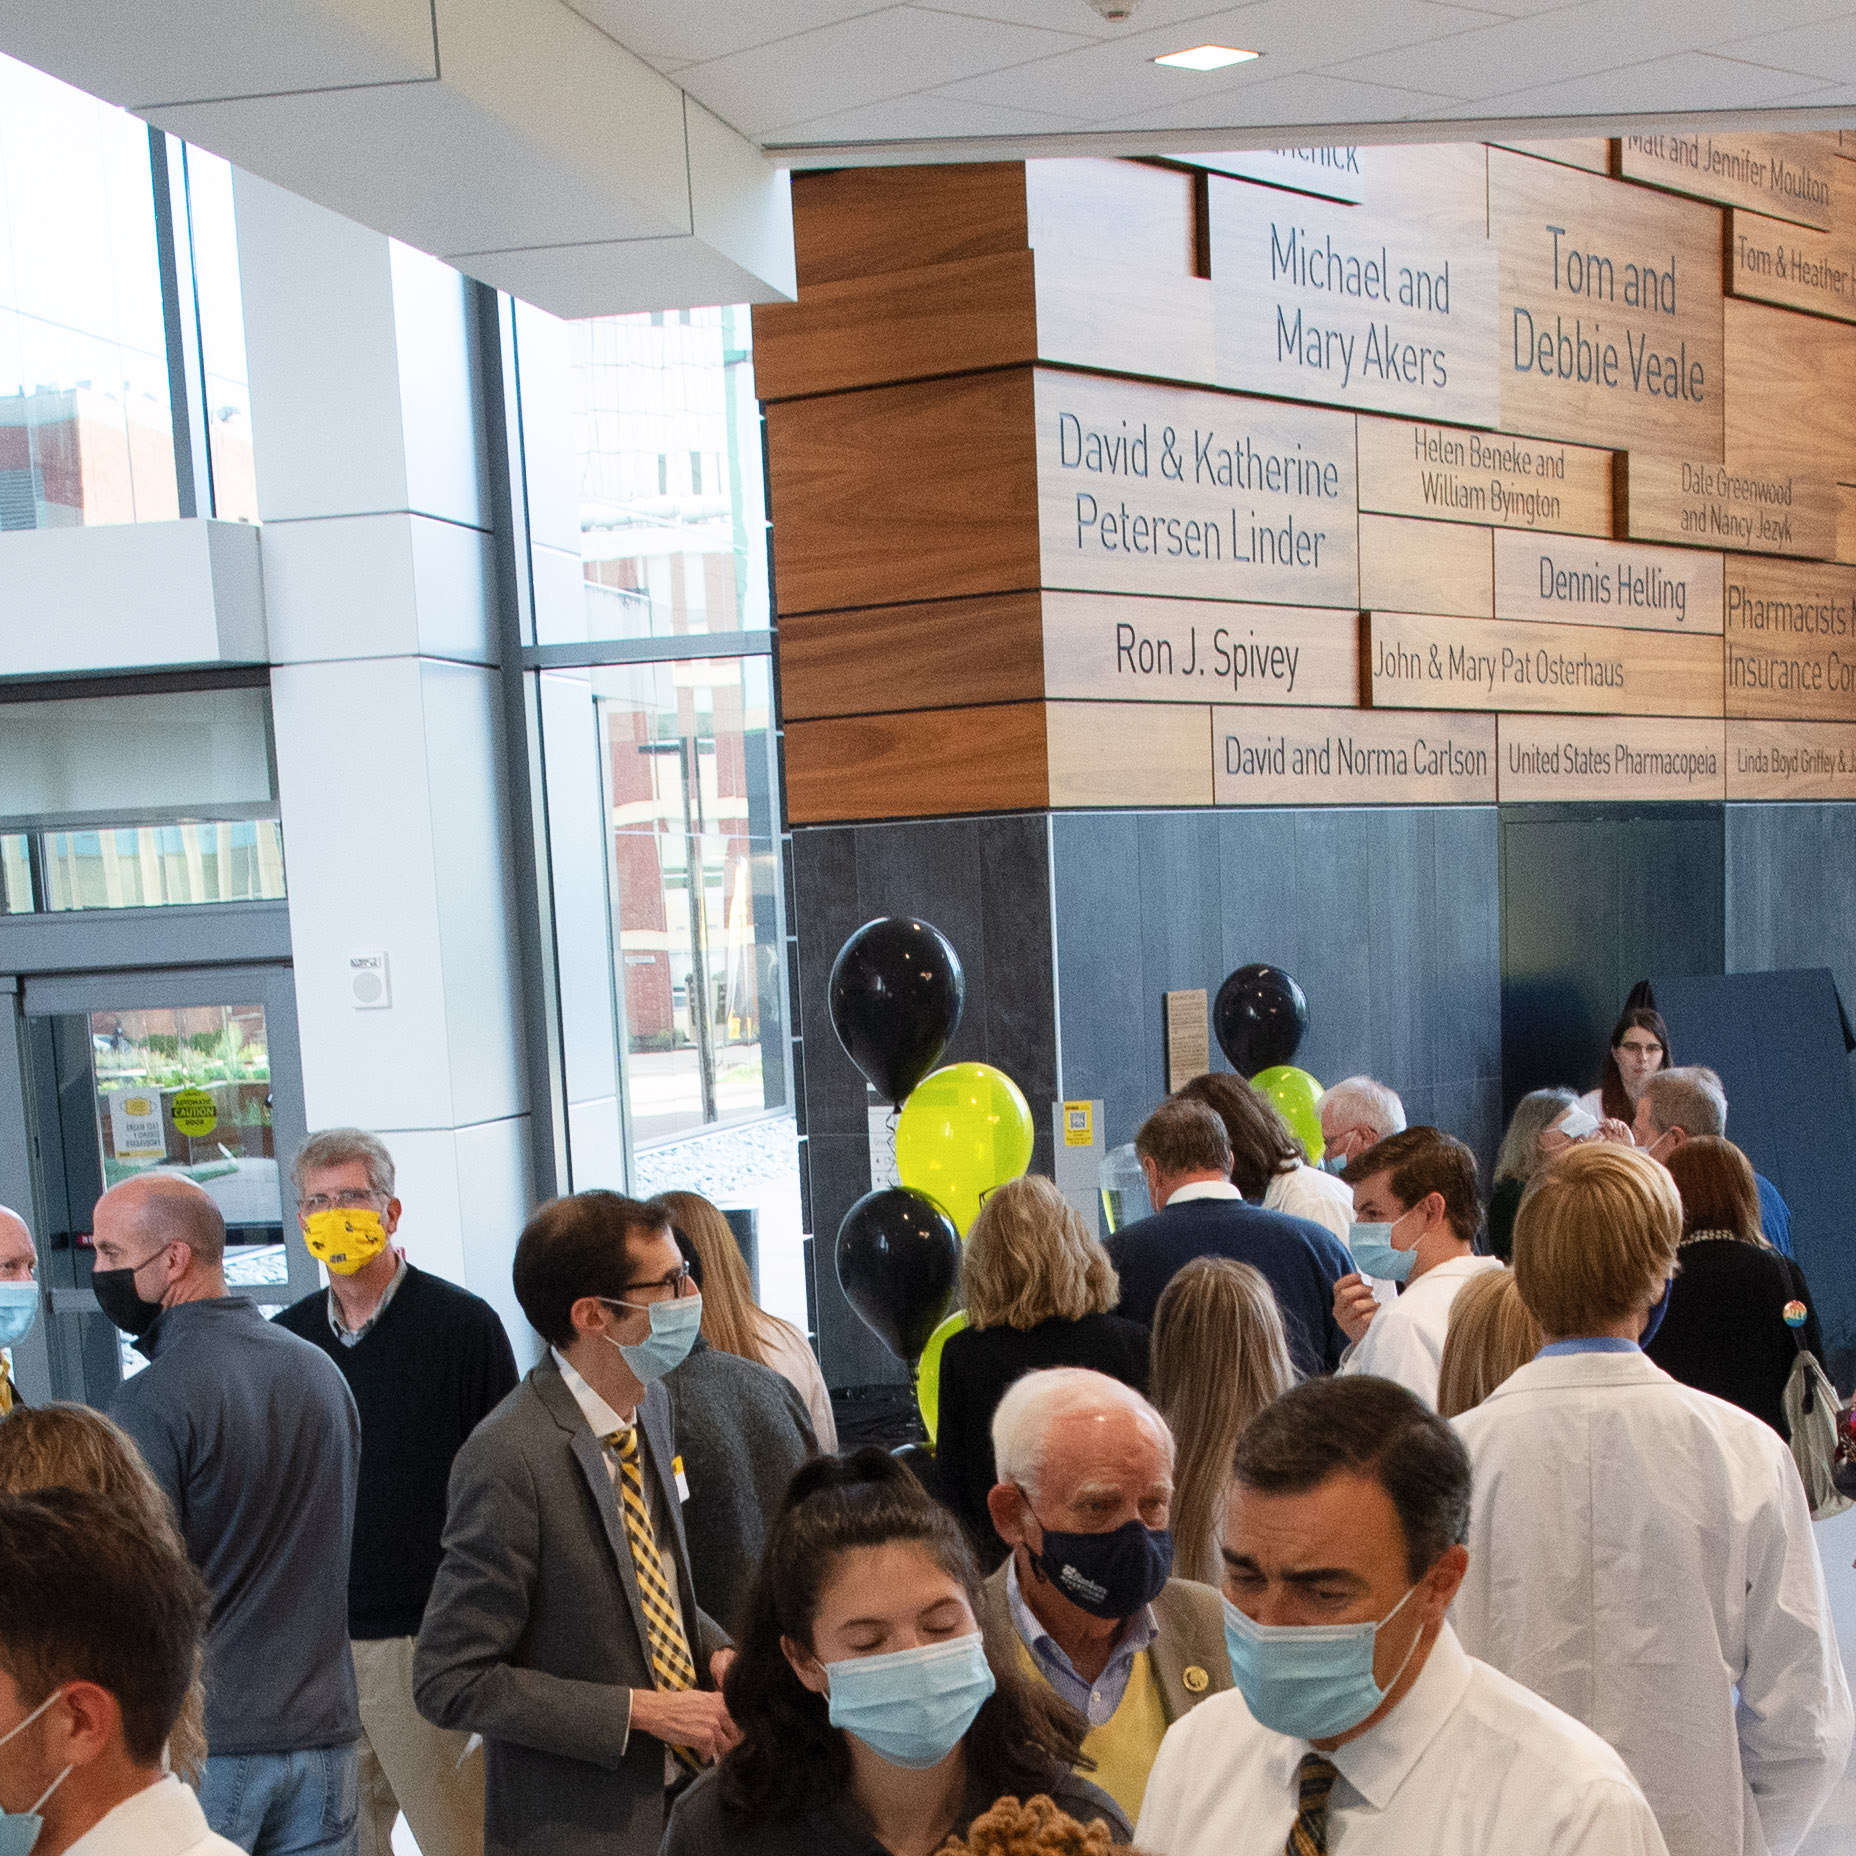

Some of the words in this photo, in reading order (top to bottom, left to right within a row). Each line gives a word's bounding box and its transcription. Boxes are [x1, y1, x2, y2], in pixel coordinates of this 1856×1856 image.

[1668, 135, 1699, 169] and
[1703, 139, 1766, 188] Jennifer
[1770, 157, 1830, 206] Moulton
[1271, 221, 1390, 302] Michael
[1398, 260, 1451, 316] and
[1546, 224, 1616, 302] Tom
[1624, 254, 1677, 316] and
[1739, 236, 1771, 276] Tom
[1775, 246, 1789, 279] &
[1791, 253, 1849, 295] Heather
[1276, 304, 1355, 389] Mary
[1363, 321, 1447, 389] Akers
[1512, 306, 1619, 387] Debbie
[1626, 329, 1706, 403] Veale
[1059, 411, 1148, 479] David
[1160, 425, 1184, 482] &
[1194, 428, 1339, 499] Katherine
[1414, 426, 1465, 466] Helen
[1470, 435, 1531, 477] Beneke
[1536, 447, 1565, 480] and
[1421, 470, 1486, 512] William
[1491, 480, 1561, 525] Byington
[1681, 461, 1714, 495] Dale
[1717, 465, 1793, 507] Greenwood
[1076, 493, 1221, 561] Petersen
[1231, 507, 1325, 569] Linder
[1681, 498, 1706, 534] and
[1710, 503, 1754, 544] Nancy
[1539, 555, 1611, 606] Dennis
[1617, 564, 1687, 623] Helling
[1728, 583, 1845, 636] Pharmacists
[1117, 622, 1173, 677] Ron
[1182, 626, 1205, 677] J.
[1213, 629, 1300, 693] Spivey
[1373, 639, 1421, 681] John
[1428, 643, 1443, 681] &
[1448, 645, 1496, 692] Mary
[1501, 649, 1532, 686] Pat
[1536, 649, 1624, 689] Osterhaus
[1727, 642, 1822, 691] Insurance
[1224, 734, 1285, 776] David
[1292, 735, 1330, 776] and
[1338, 737, 1408, 777] Norma
[1413, 738, 1487, 777] Carlson
[1508, 743, 1560, 776] United
[1563, 744, 1611, 776] States
[1615, 745, 1717, 783] Pharmacopeia
[1738, 747, 1768, 774] Linda
[1771, 747, 1798, 779] Boyd
